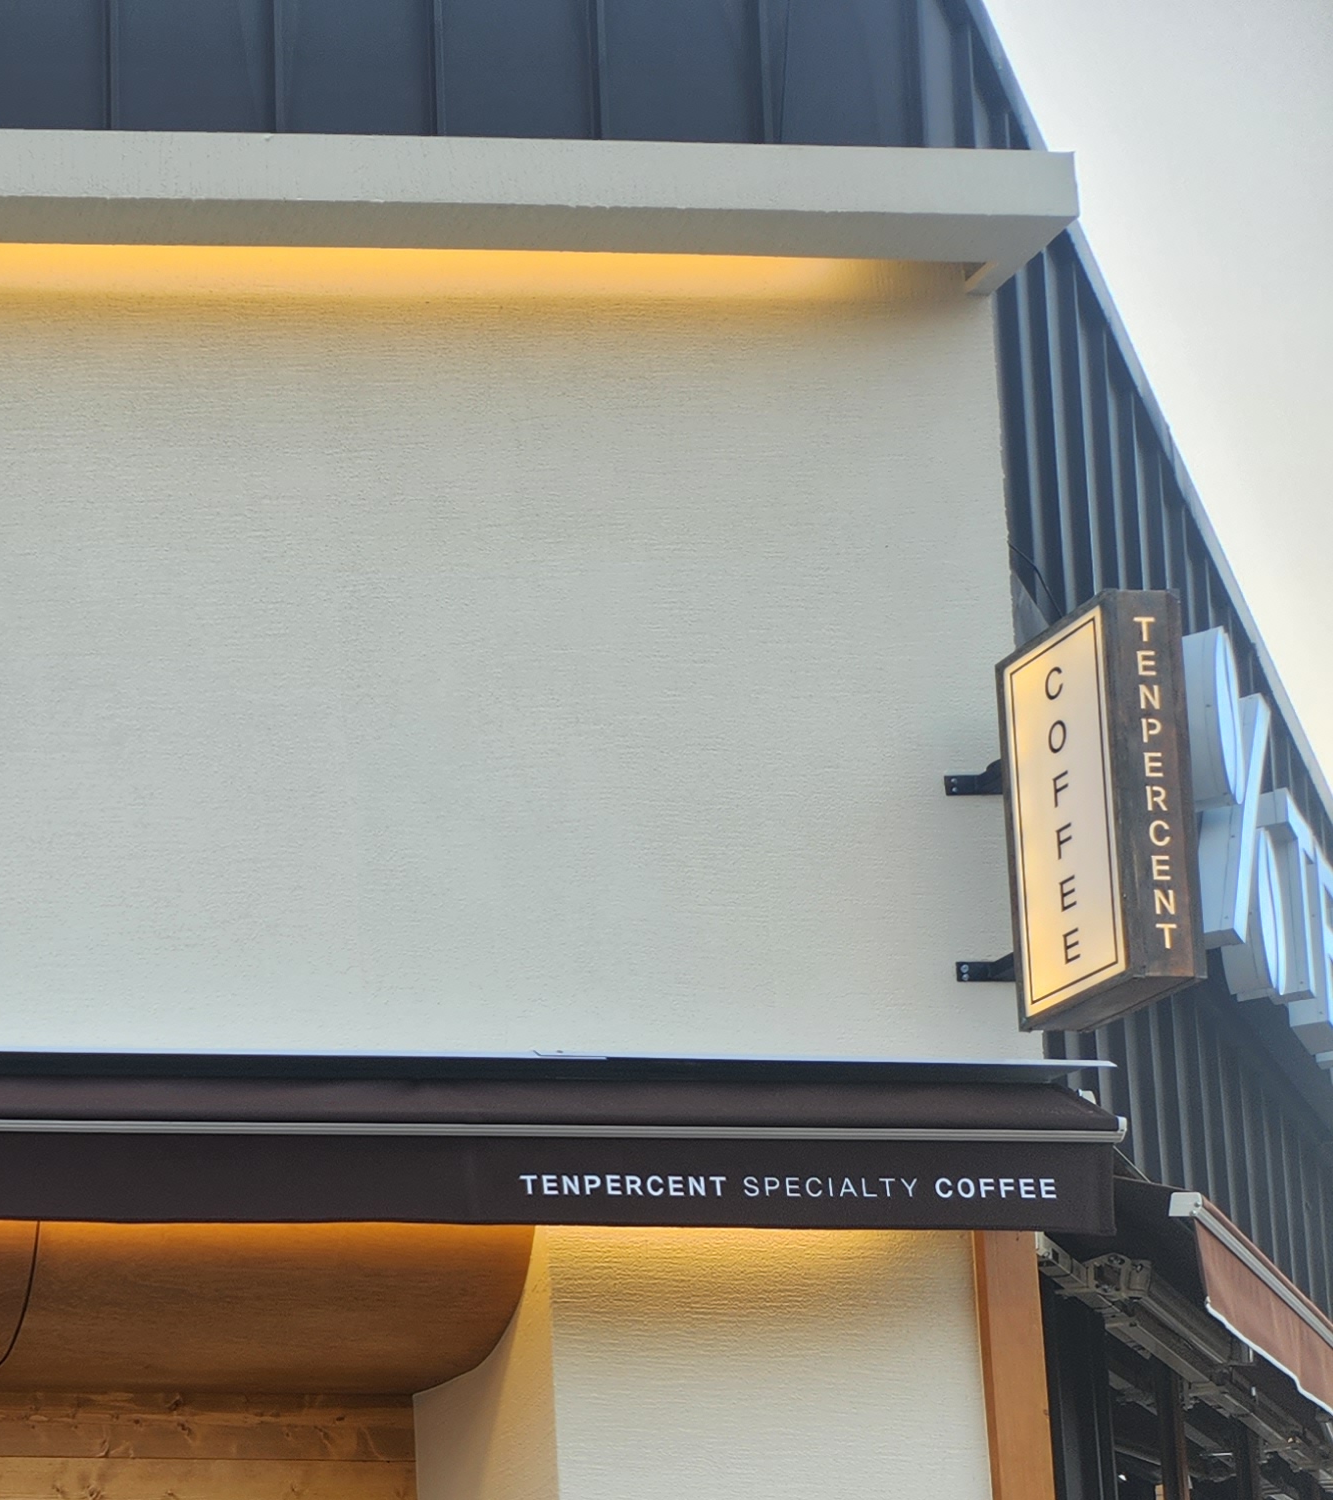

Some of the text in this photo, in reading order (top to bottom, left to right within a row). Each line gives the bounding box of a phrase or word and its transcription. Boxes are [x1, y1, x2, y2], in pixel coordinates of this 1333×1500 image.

[1044, 666, 1081, 965] COFFEE
[1134, 616, 1177, 950] TENPERCENT
[519, 1174, 1058, 1200] TENPERCENT SPECIALTY COFFEE
